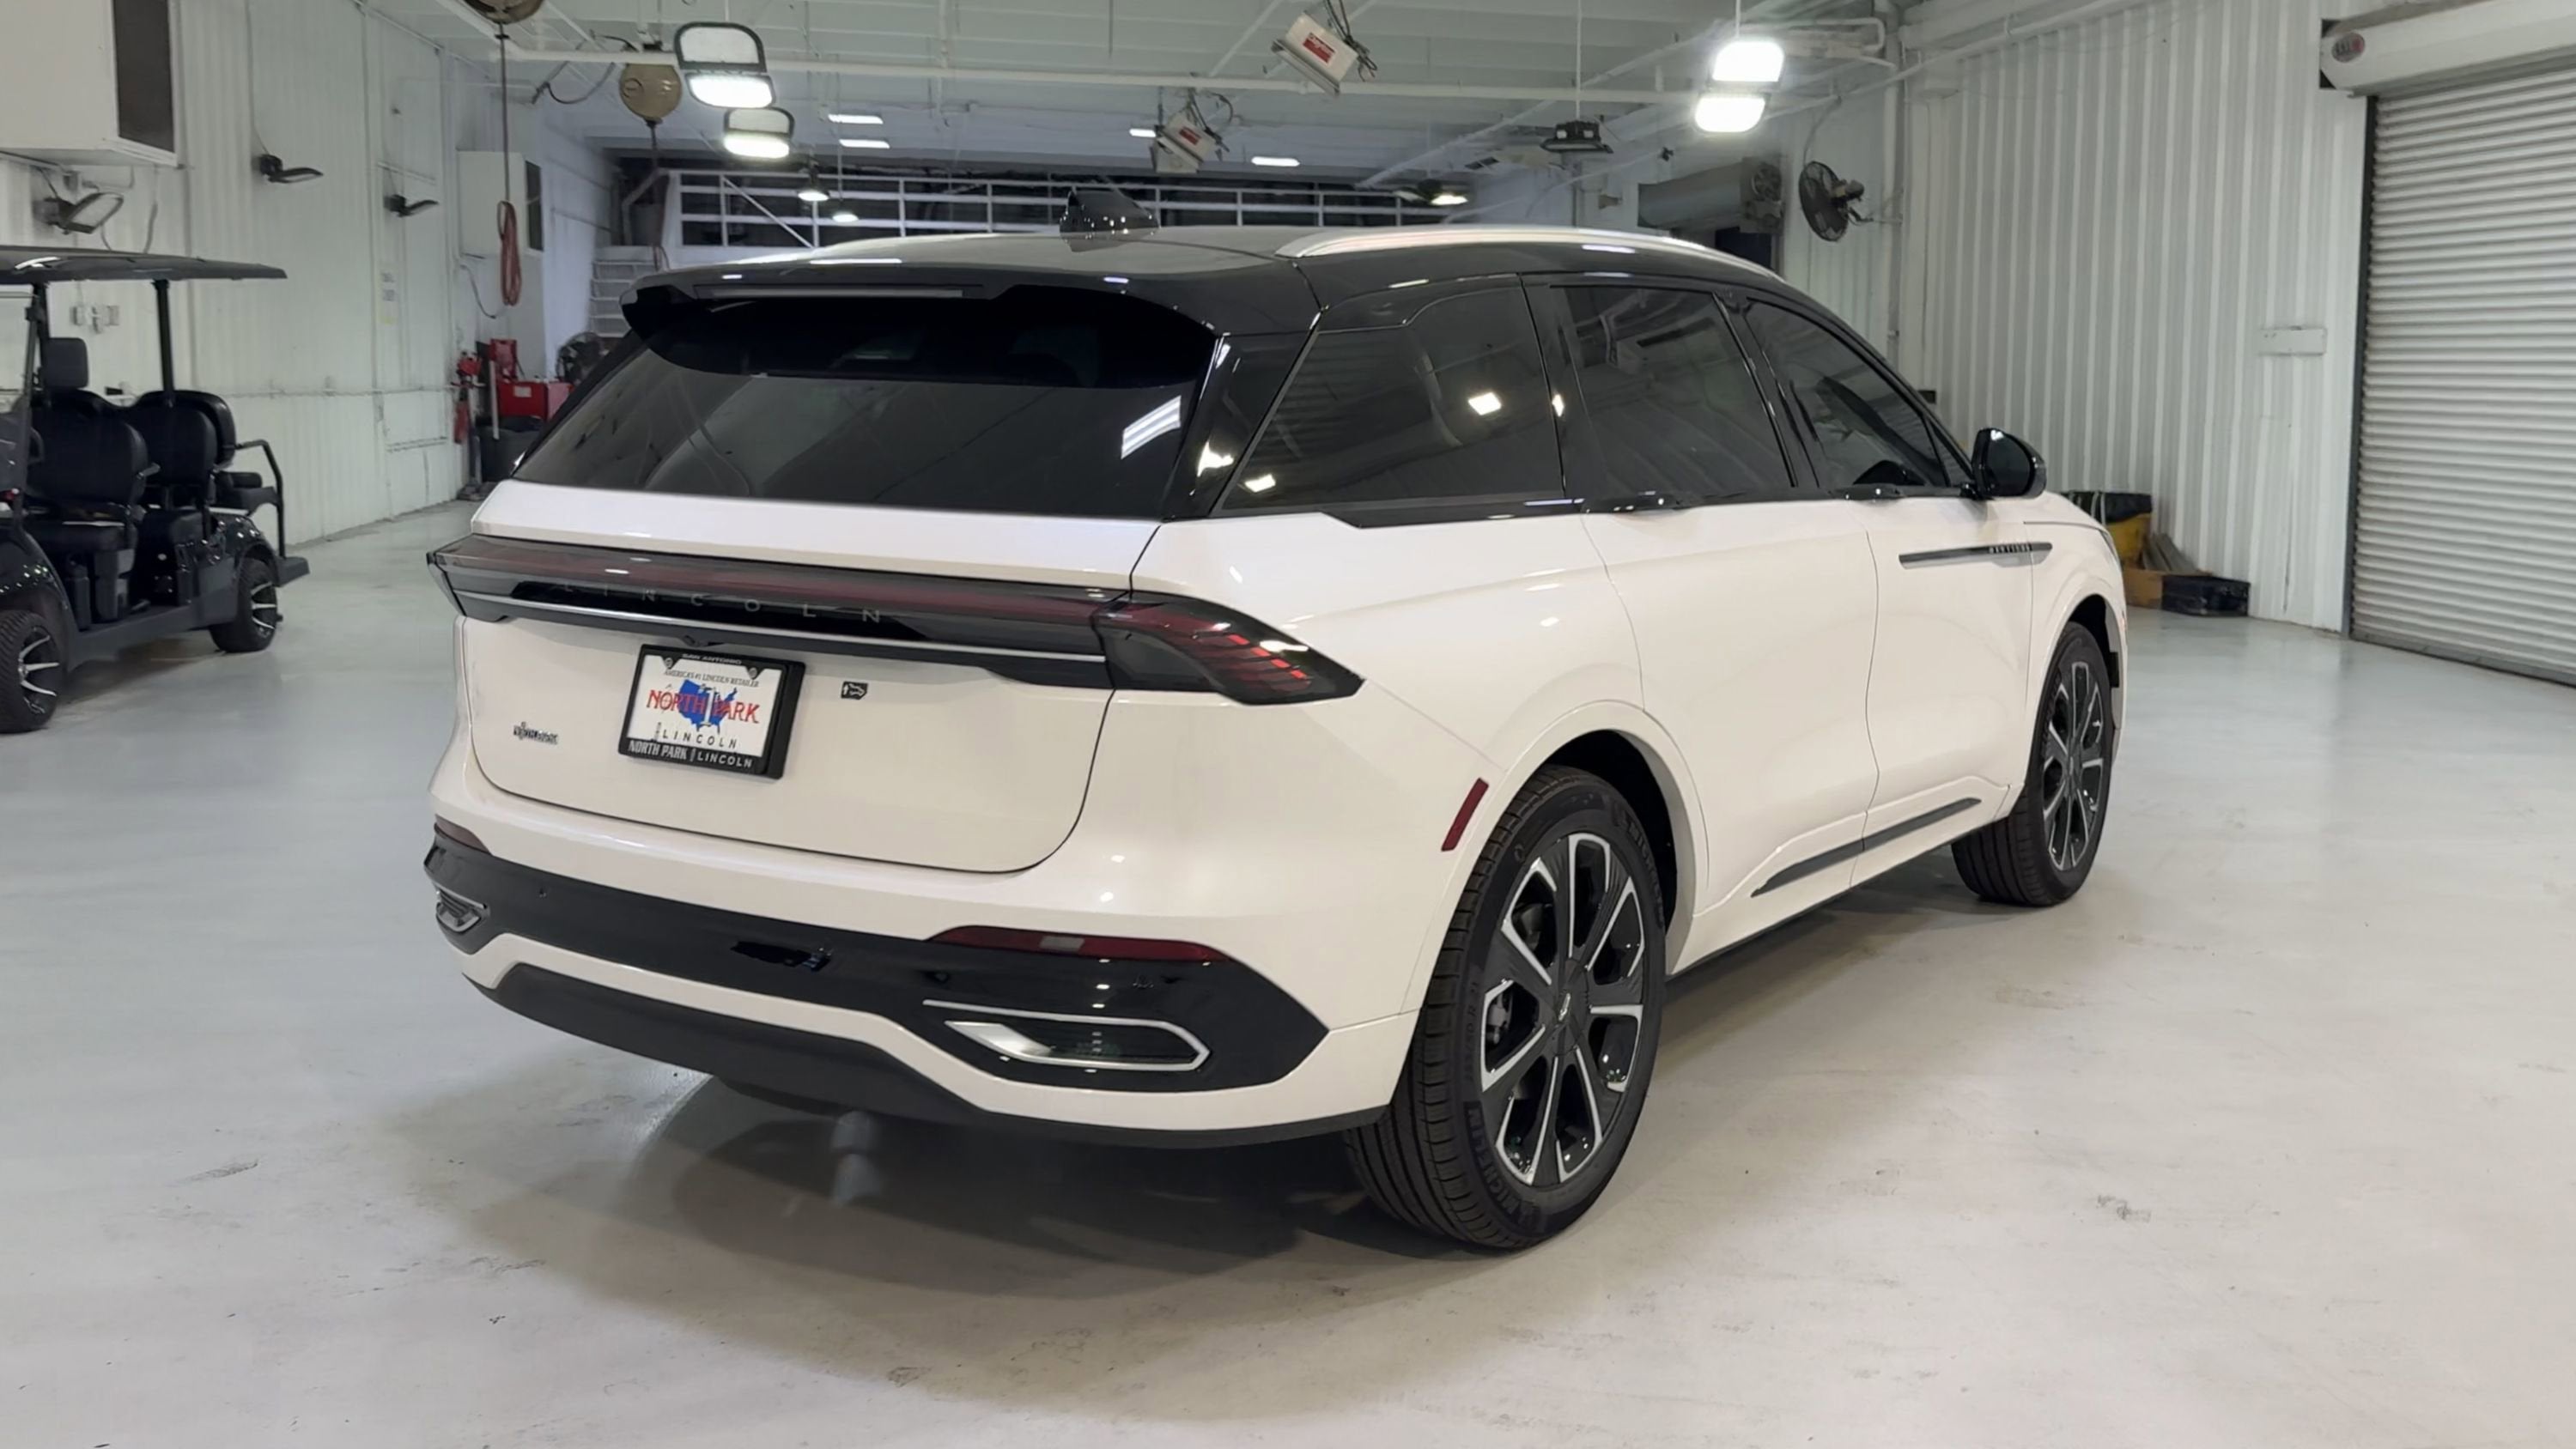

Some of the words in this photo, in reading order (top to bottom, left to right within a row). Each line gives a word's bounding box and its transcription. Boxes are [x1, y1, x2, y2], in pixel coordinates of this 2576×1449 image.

[564, 583, 880, 624] LINCOLN
[664, 670, 694, 679] AMERICAS
[646, 688, 707, 714] NORTH
[712, 699, 760, 724] PARK
[629, 740, 659, 755] NORTH
[660, 744, 688, 760] PARK
[696, 752, 753, 767] LINCOLN
[663, 729, 738, 749] LINCOLN
[1467, 1106, 1521, 1216] MICHELIN
